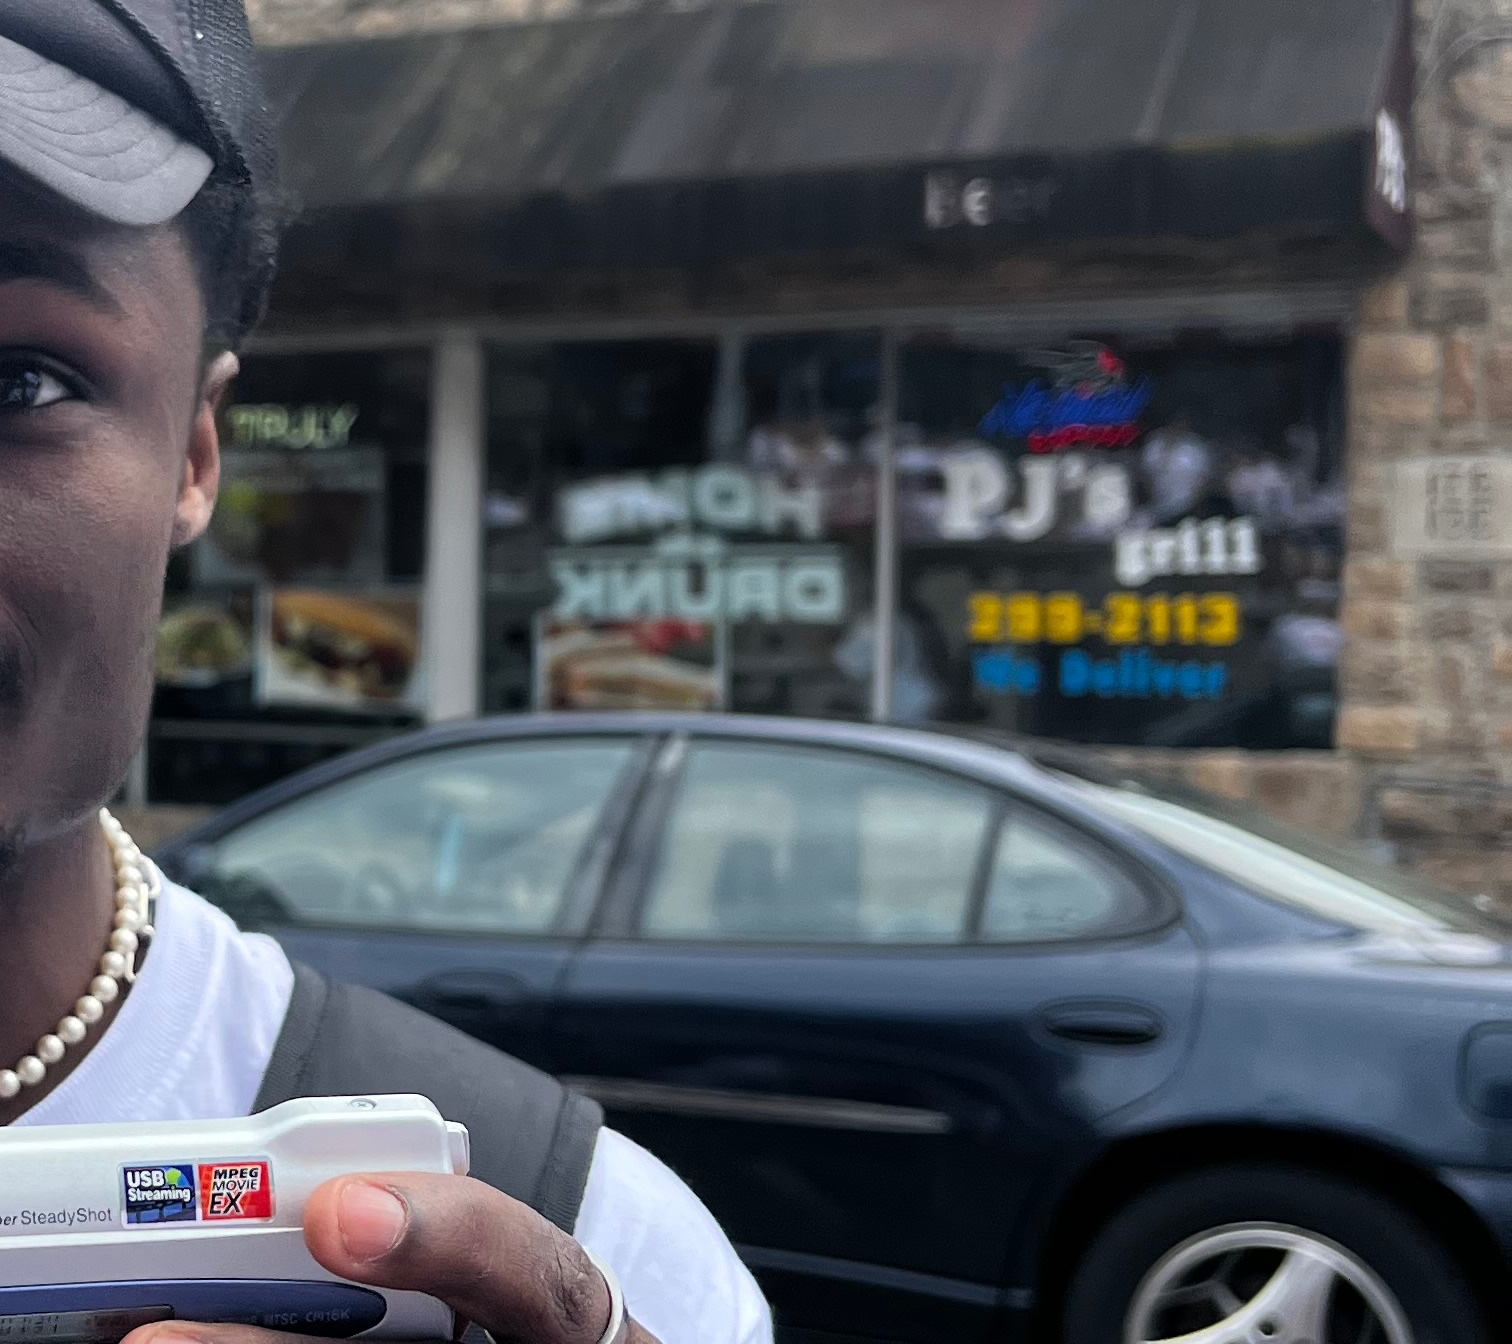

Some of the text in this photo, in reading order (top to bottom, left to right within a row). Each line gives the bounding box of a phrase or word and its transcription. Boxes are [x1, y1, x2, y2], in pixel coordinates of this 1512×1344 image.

[939, 452, 1133, 541] PJ's
[1115, 518, 1260, 587] grill
[1059, 649, 1226, 698] Deliver
[126, 1169, 165, 1187] USB
[213, 1167, 259, 1179] MPEG
[212, 1178, 258, 1191] MOVIE
[128, 1187, 191, 1202] Streaming
[209, 1192, 243, 1215] EX
[20, 1208, 113, 1227] SteadyShot
